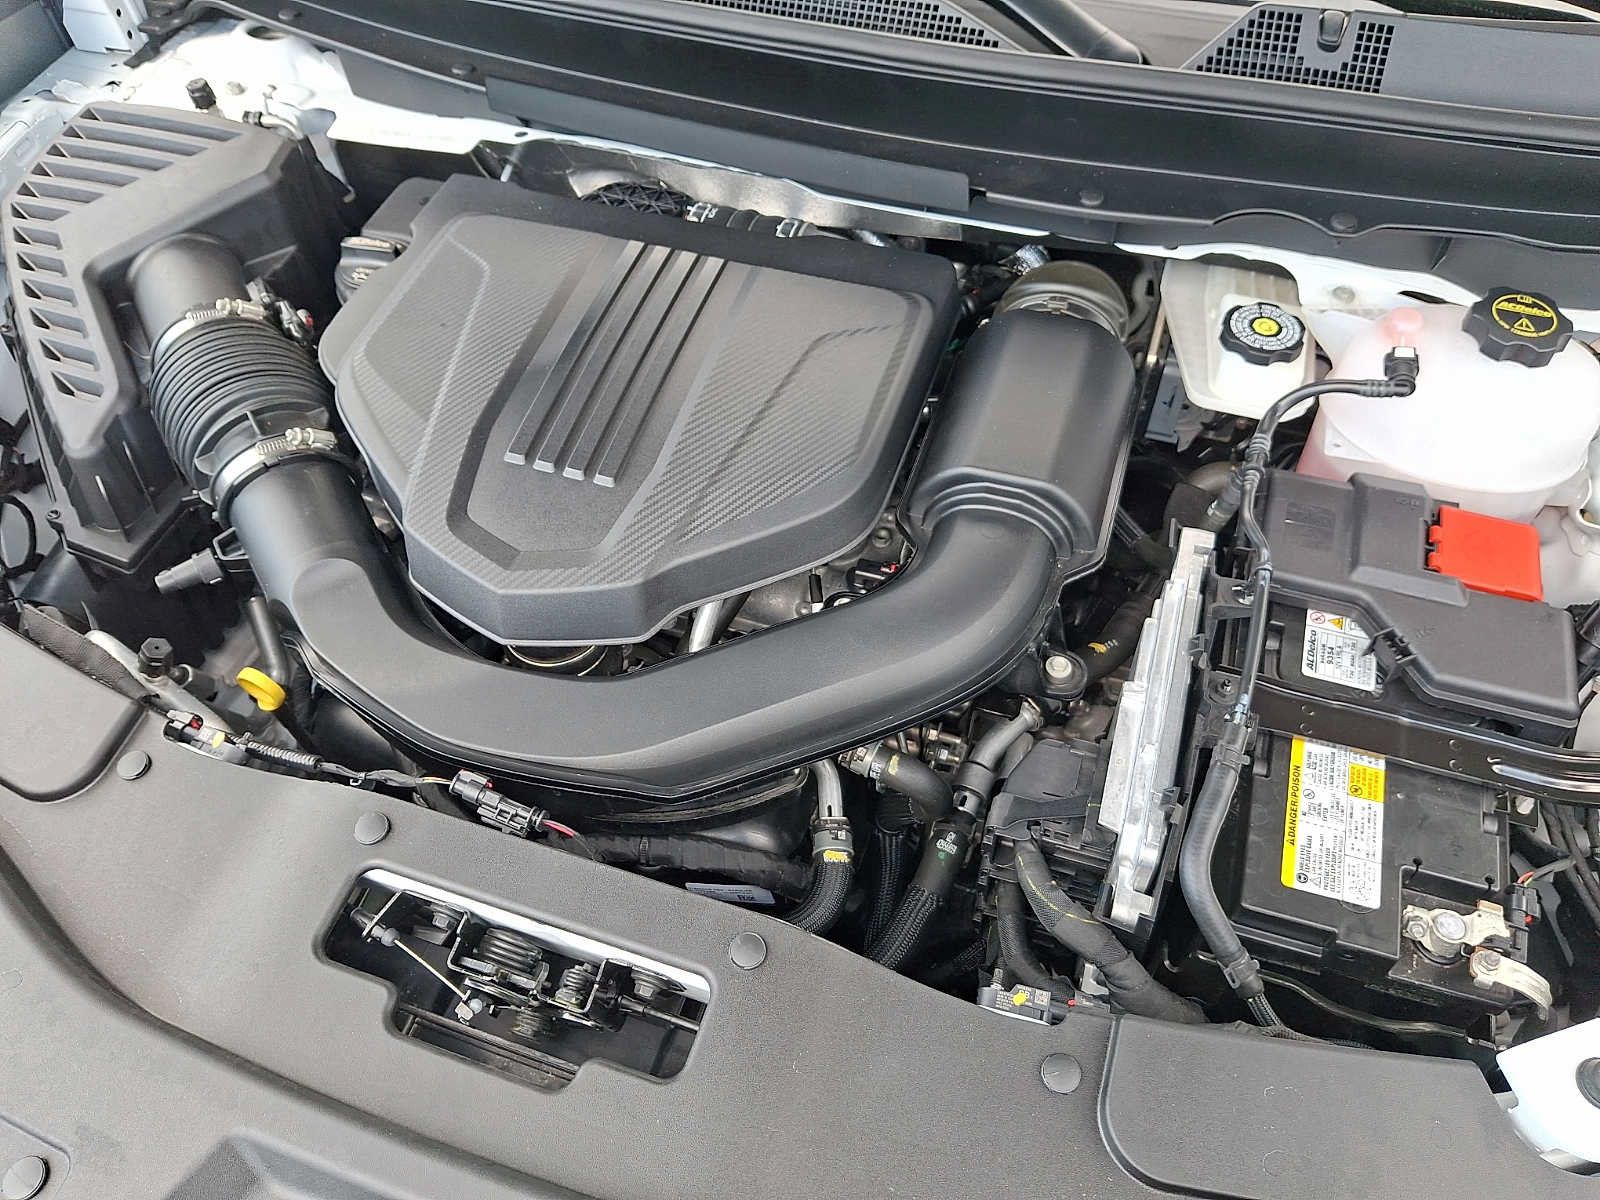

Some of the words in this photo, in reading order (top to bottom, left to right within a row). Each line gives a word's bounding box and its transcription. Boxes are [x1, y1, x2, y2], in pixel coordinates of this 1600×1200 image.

[1306, 630, 1316, 671] ACDelco
[1326, 646, 1334, 665] 9354
[1288, 765, 1300, 837] DANGER/POISON
